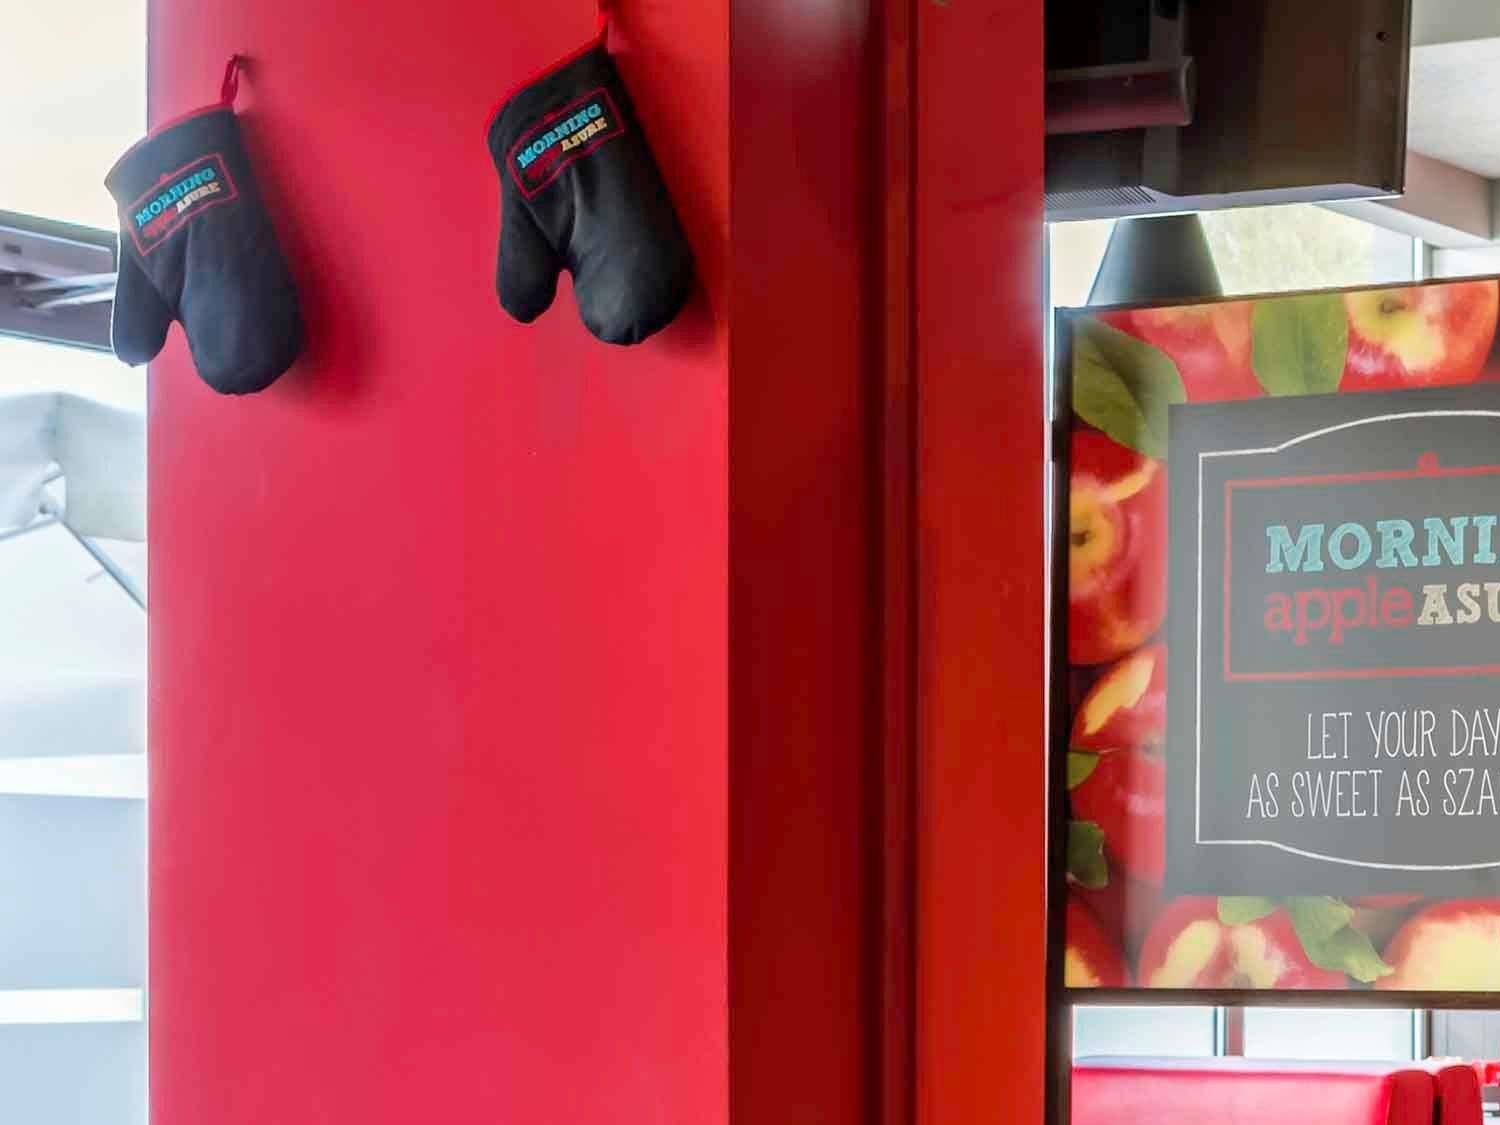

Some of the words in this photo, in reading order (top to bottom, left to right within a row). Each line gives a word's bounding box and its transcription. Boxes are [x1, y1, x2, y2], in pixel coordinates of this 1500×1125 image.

[517, 103, 602, 169] MORNING
[1306, 711, 1353, 760] LET
[1365, 710, 1437, 759] YOUR
[1246, 772, 1280, 819] AS
[1291, 769, 1383, 817] SWEET
[1395, 769, 1431, 816] AS
